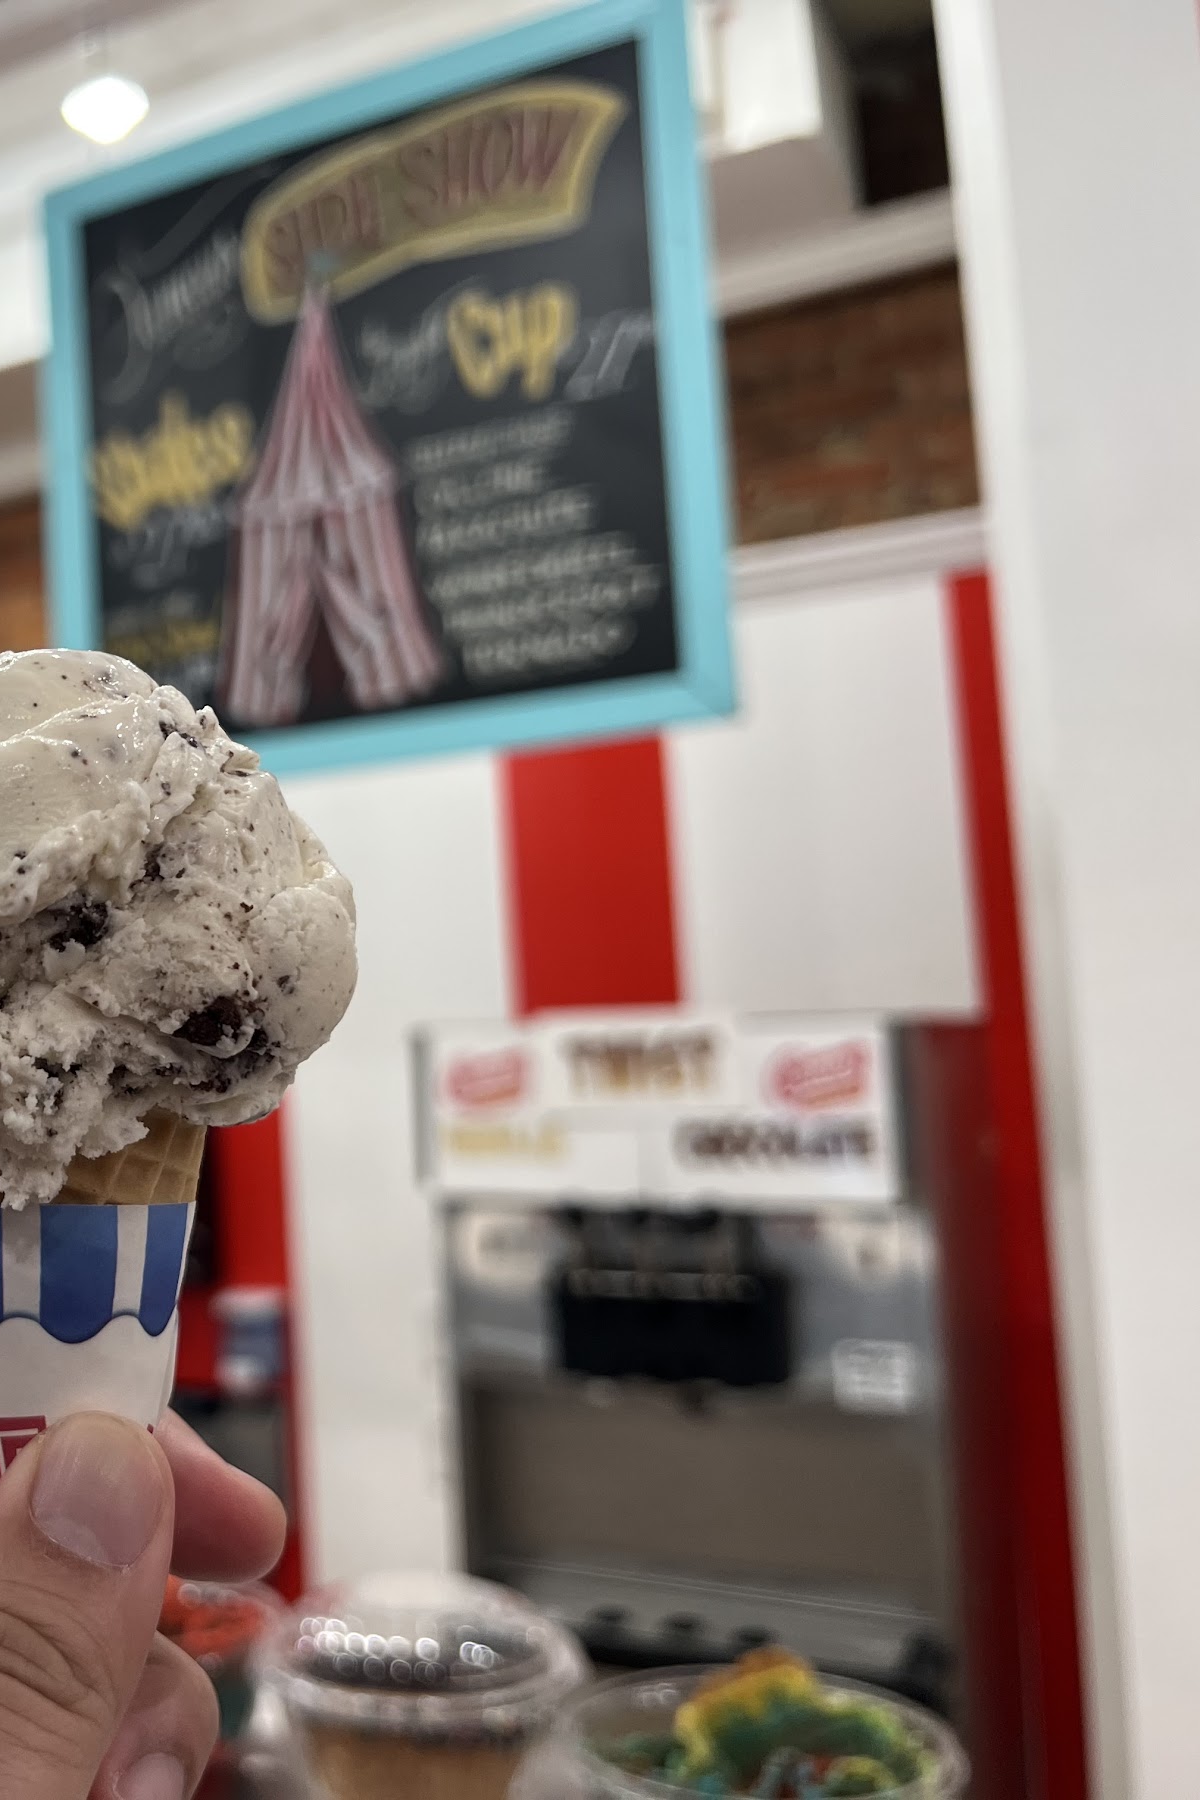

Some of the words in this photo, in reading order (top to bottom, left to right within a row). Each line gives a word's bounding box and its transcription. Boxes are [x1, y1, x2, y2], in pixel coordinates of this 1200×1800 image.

[402, 106, 590, 222] SHOW
[566, 1031, 715, 1093] TWIST
[678, 1120, 874, 1164] CHOCOLATE
